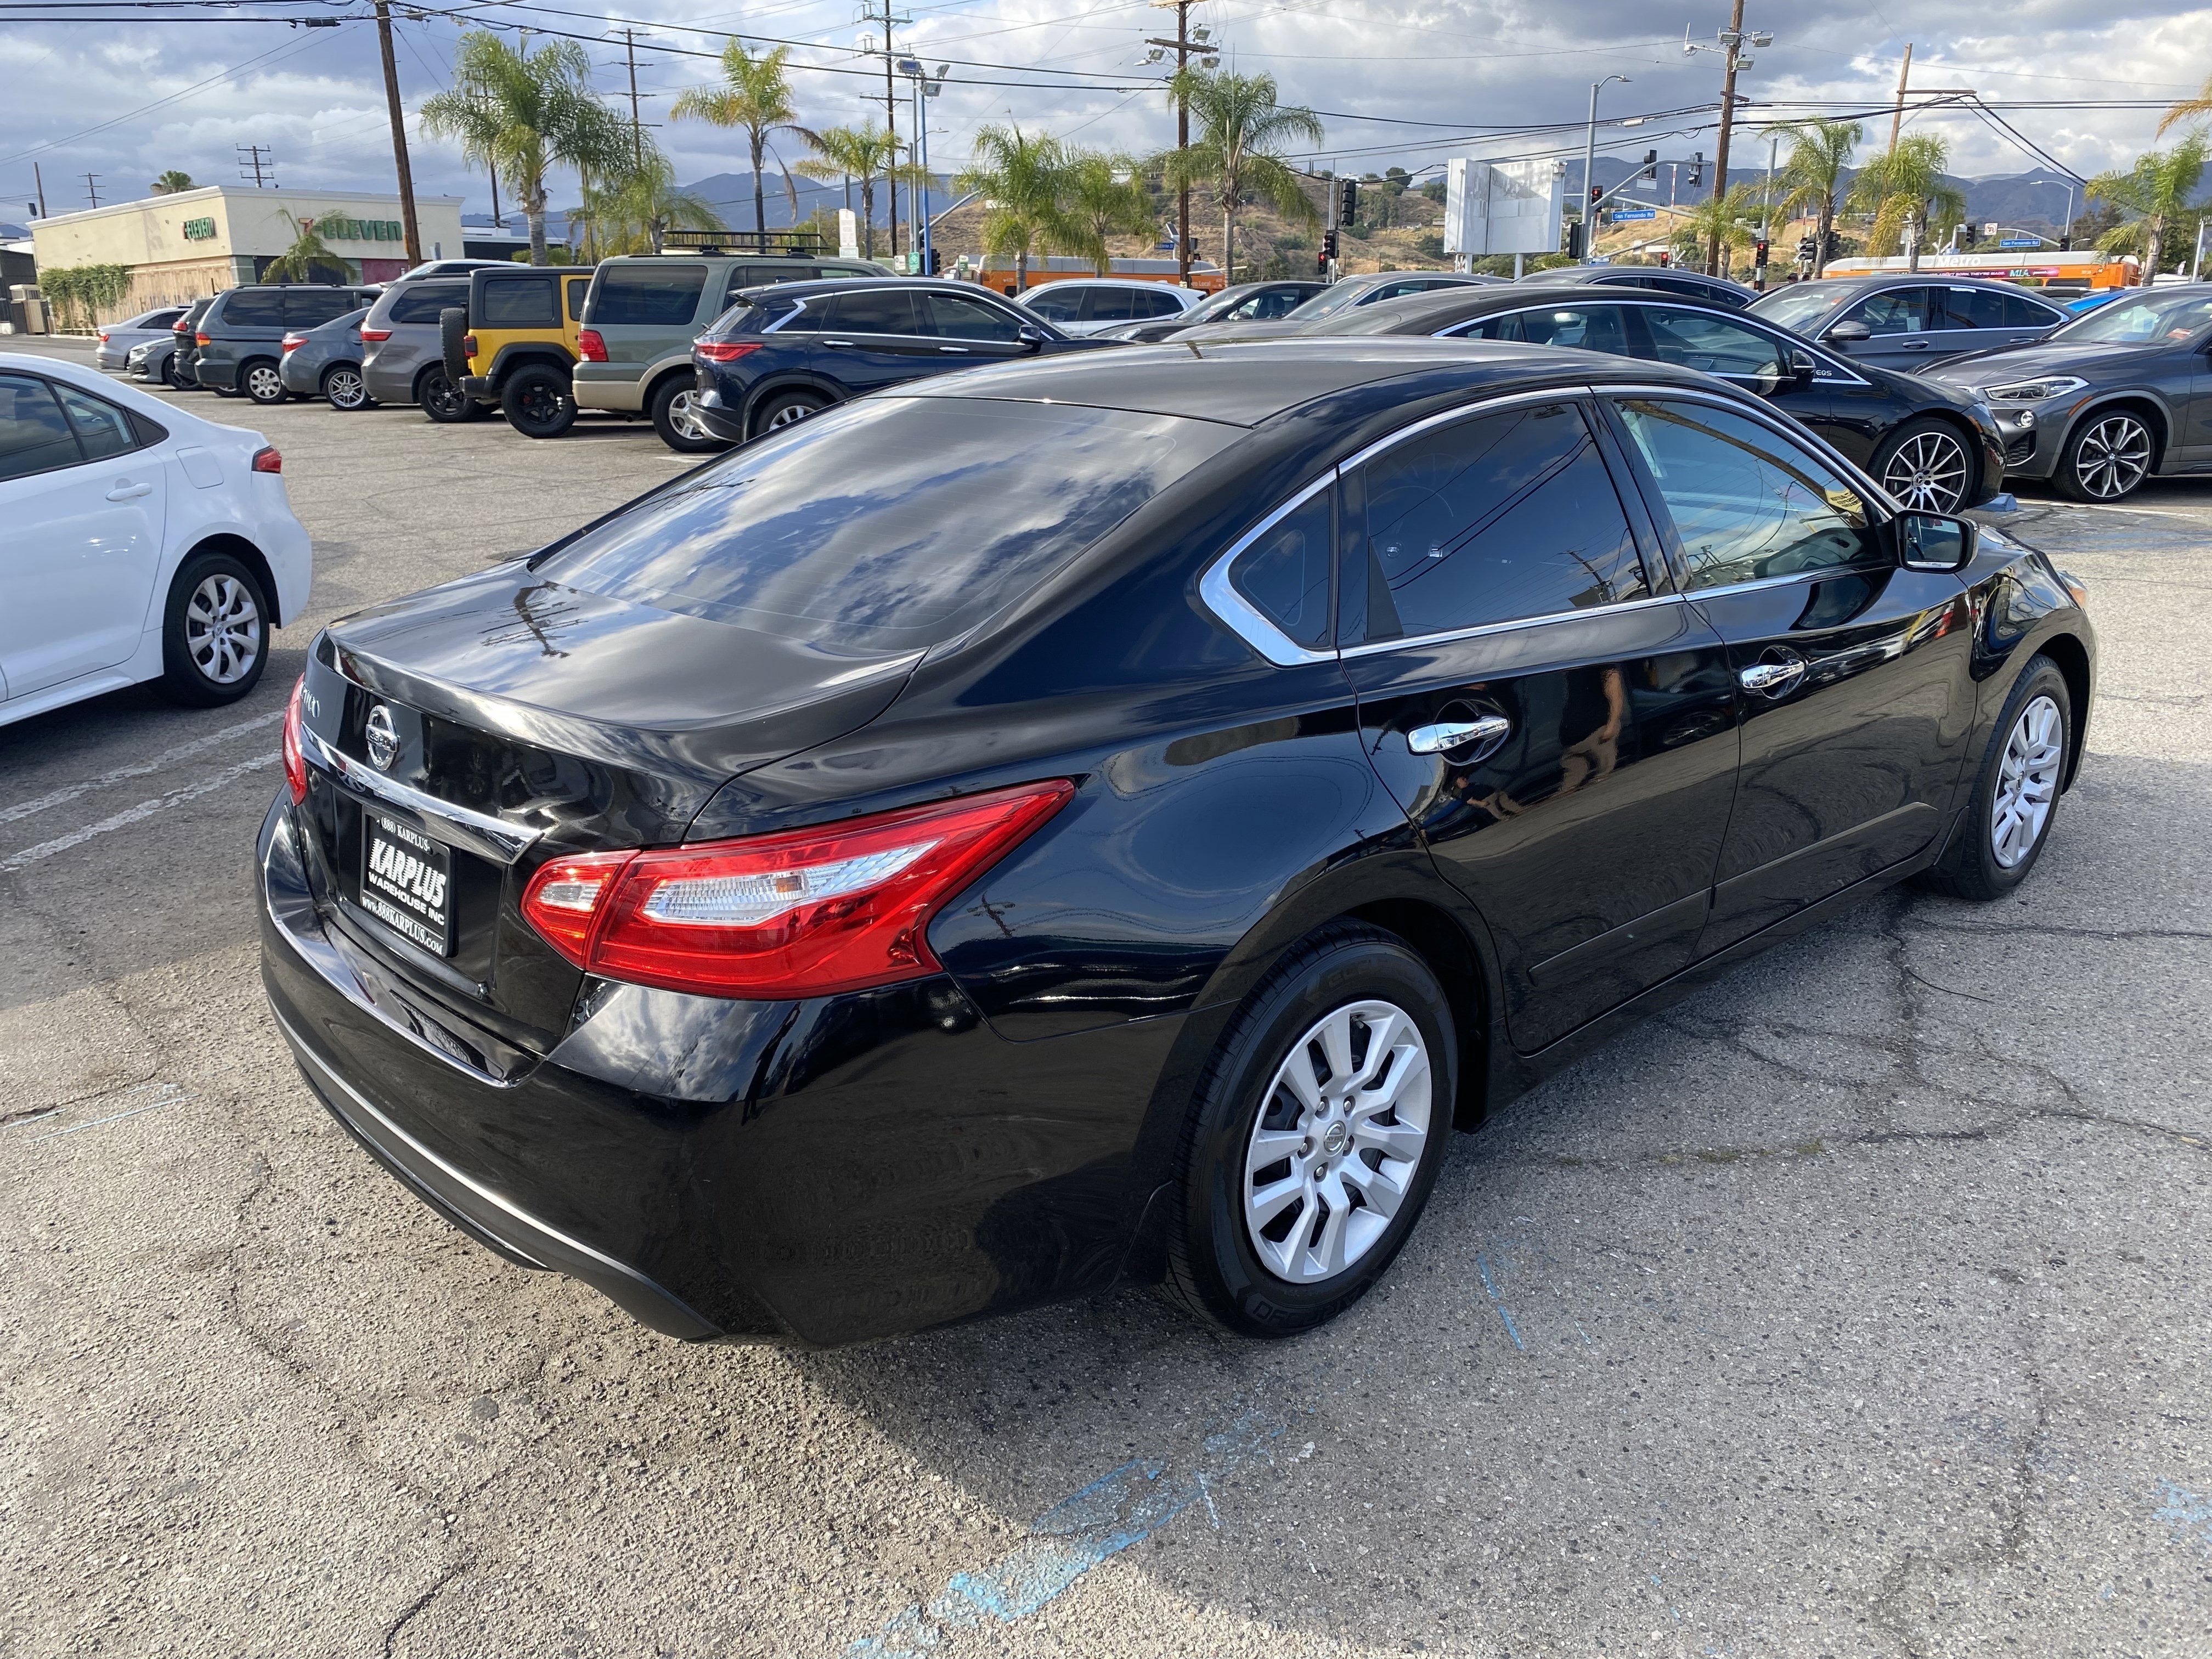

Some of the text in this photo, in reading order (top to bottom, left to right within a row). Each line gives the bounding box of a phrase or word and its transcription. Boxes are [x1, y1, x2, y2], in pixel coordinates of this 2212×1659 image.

[1937, 255, 1981, 267] Metro
[381, 816, 428, 851] (888) KARPLUS
[369, 838, 447, 908] KARPLUS
[368, 871, 445, 926] WAREHOUSE INC
